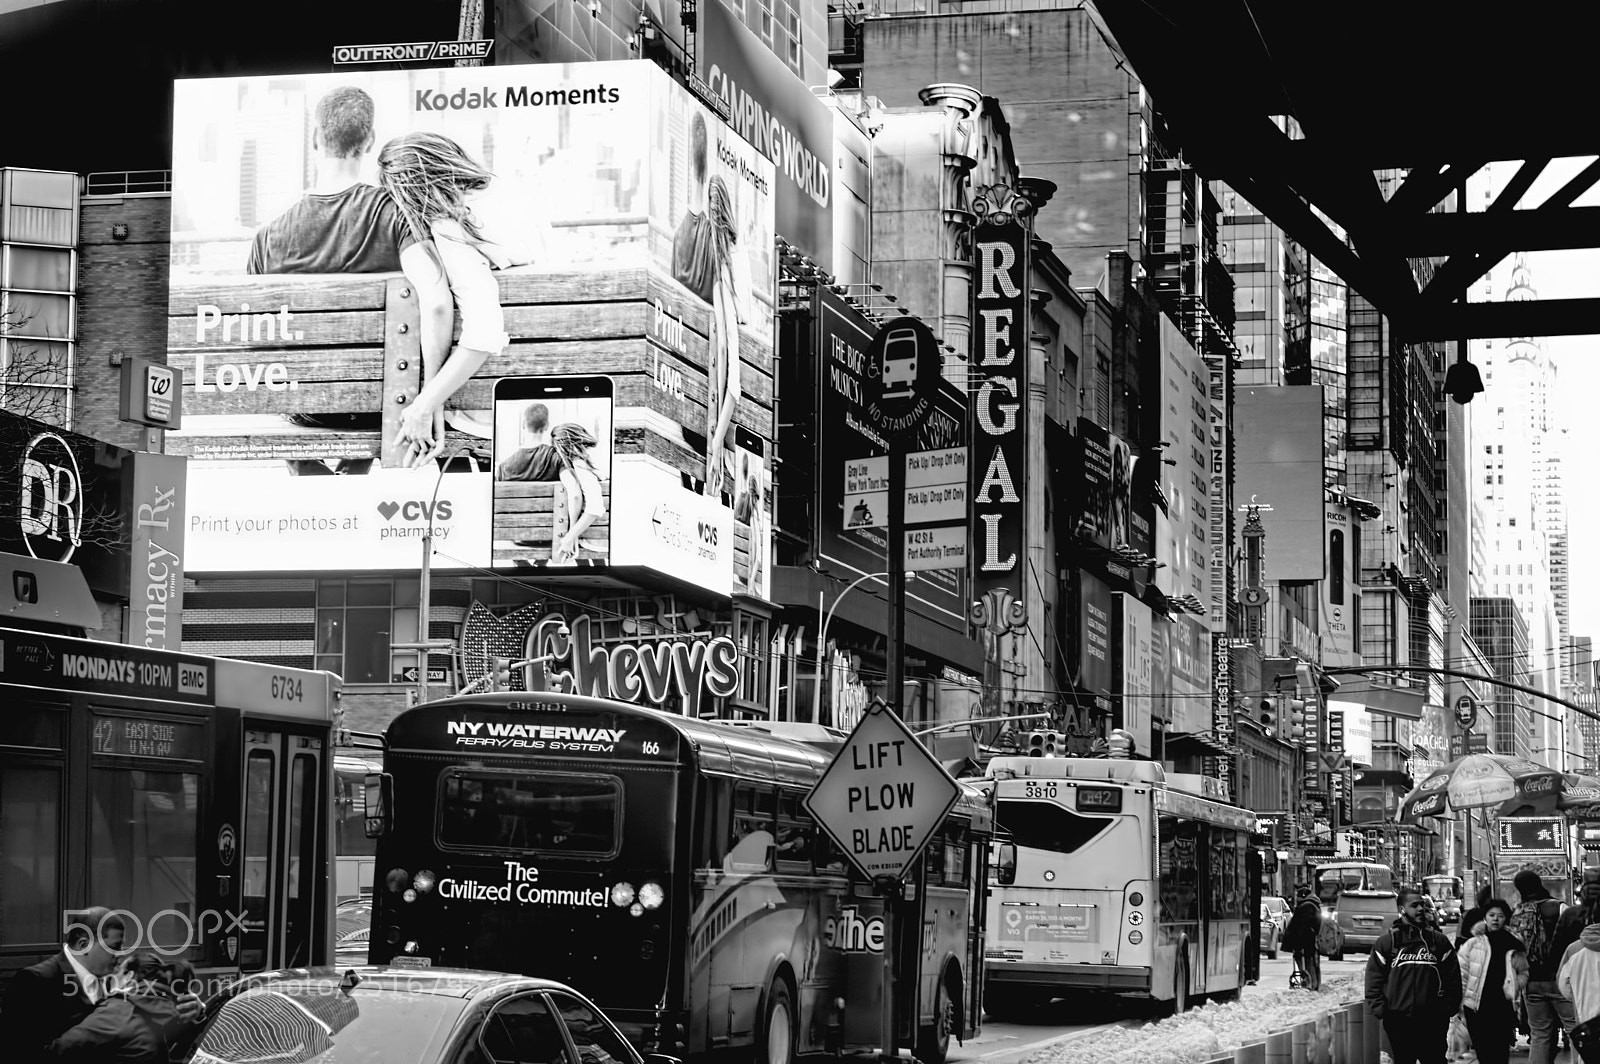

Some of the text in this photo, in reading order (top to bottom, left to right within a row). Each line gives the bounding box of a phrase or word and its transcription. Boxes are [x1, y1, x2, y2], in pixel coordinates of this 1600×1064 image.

[337, 42, 486, 62] OUTFRONT PRIME
[415, 83, 620, 112] Kodak Moments
[716, 137, 768, 196] Kodak Moments
[781, 124, 829, 208] WORLD
[196, 302, 304, 343] Print.
[654, 297, 687, 354] Print.
[830, 333, 846, 364] THE
[194, 354, 299, 393] Love.
[653, 347, 684, 402] Love.
[868, 402, 881, 421] NO
[882, 397, 928, 431] STANDING
[975, 241, 1021, 572] REGAL
[859, 464, 868, 477] Line
[909, 458, 920, 470] Pick
[931, 456, 944, 469] Drop
[945, 453, 953, 466] Off
[954, 452, 965, 467] Only
[848, 480, 857, 491] New
[858, 478, 867, 490] York
[867, 478, 879, 490] Tours
[908, 493, 919, 505] Pick
[930, 490, 943, 504] Drop
[944, 489, 952, 501] Off
[953, 488, 964, 502] Only
[137, 486, 175, 531] Rx
[402, 500, 453, 521] CVS
[1327, 512, 1347, 522] RICOH
[191, 514, 358, 535] Print your photos at
[380, 525, 450, 540] pharmacy
[704, 523, 718, 547] CVS
[908, 533, 914, 545] W
[914, 533, 921, 544] 42
[145, 539, 180, 650] rmacy
[169, 573, 177, 598] WITHIN
[1328, 622, 1347, 631] THETA
[62, 653, 136, 684] MONDAYS
[138, 664, 172, 688] 10PM
[525, 611, 739, 718] Chevys
[271, 675, 303, 702] 6734
[93, 720, 175, 753] 42 EAST SIDE
[447, 721, 627, 743] NY WATERWAY
[548, 740, 614, 752] SYSTEM
[1305, 697, 1317, 787] NEW VICTORY
[1331, 714, 1342, 752] CTORY
[1409, 734, 1449, 751] COACHELLA
[642, 741, 660, 755] 166
[852, 741, 905, 770] LIFT
[848, 782, 914, 813] PLOW
[1025, 787, 1057, 798] 3810
[853, 825, 915, 854] BLADE
[503, 861, 539, 882] The
[438, 878, 610, 908] Civilized Commute!
[1391, 947, 1437, 968] Yankees
